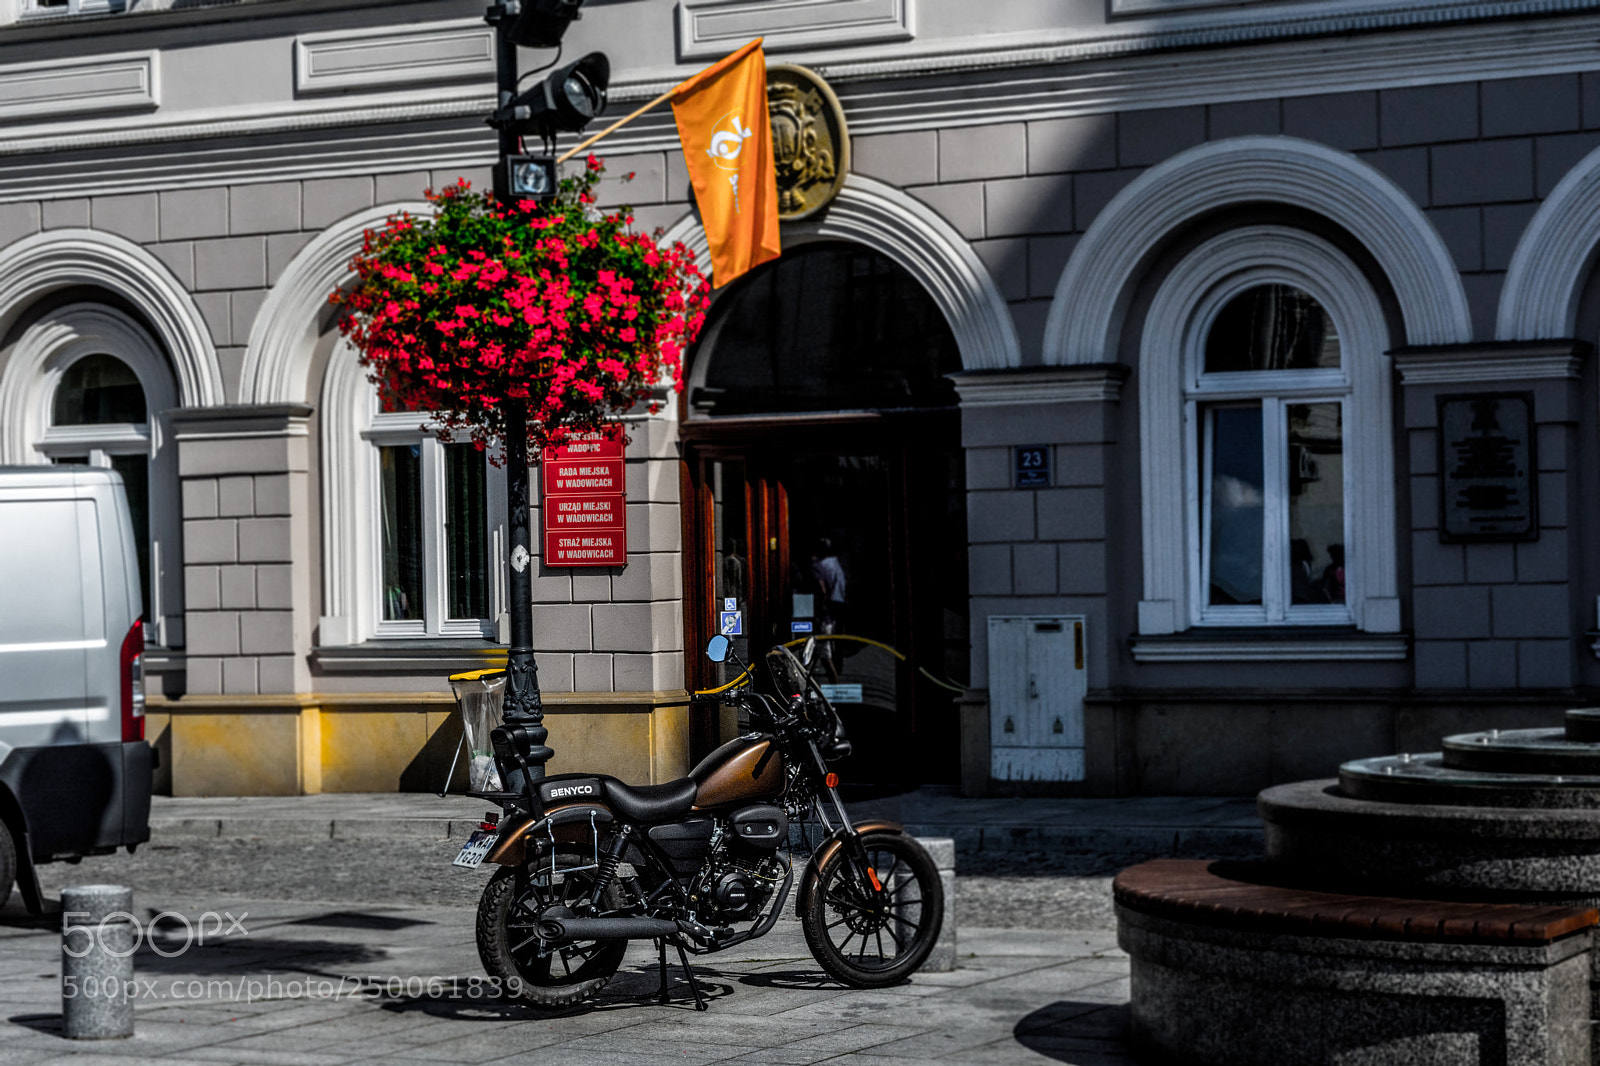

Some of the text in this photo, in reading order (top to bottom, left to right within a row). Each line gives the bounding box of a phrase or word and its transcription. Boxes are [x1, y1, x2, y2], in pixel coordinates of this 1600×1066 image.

[1022, 451, 1042, 467] 23
[559, 466, 610, 477] RADA MIEJSKA
[556, 478, 613, 488] W WADOWICACH
[558, 501, 611, 513] URZĄD MIEJSKI
[557, 513, 613, 523] W WADOWICACH
[558, 536, 613, 547] STRAŻ MIEJSKA
[558, 549, 614, 559] W WADOWICACH
[550, 785, 593, 798] BENYCO
